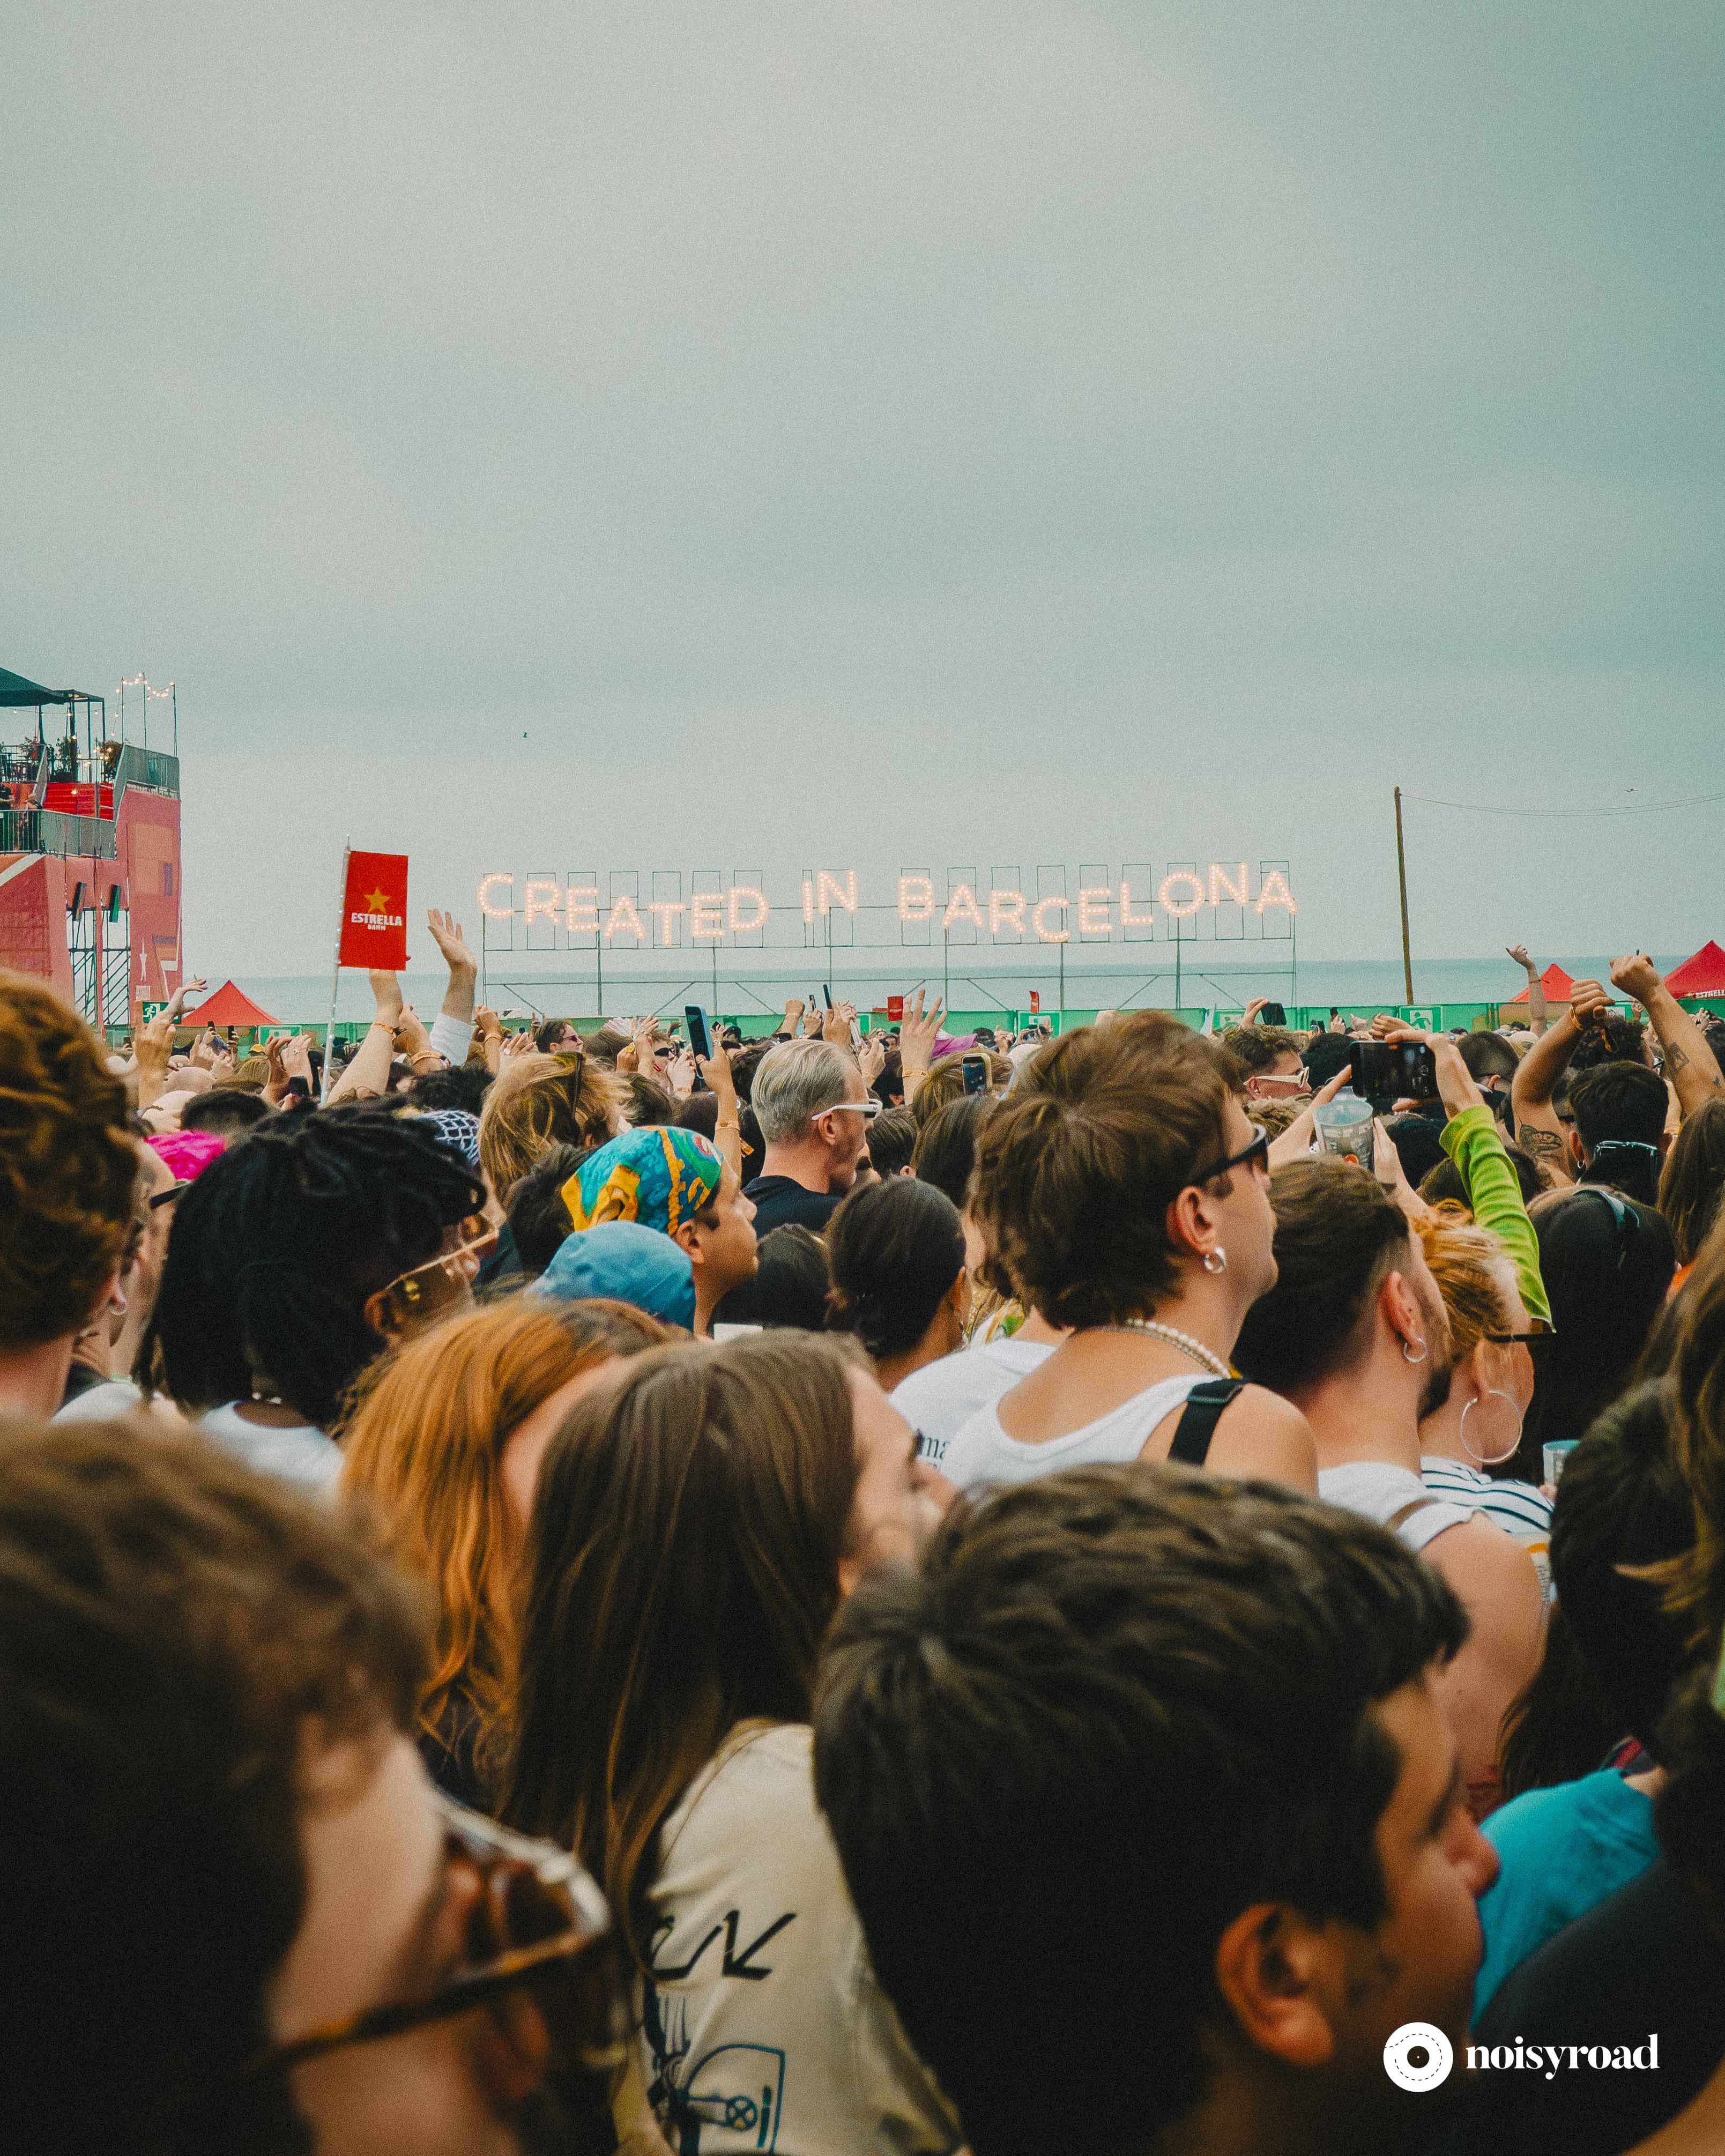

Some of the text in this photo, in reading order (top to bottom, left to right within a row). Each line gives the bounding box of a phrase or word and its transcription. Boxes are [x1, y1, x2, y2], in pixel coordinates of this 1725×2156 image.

[351, 912, 402, 926] ESTRELLA
[477, 861, 1299, 946] CREATED IN BARCELONA
